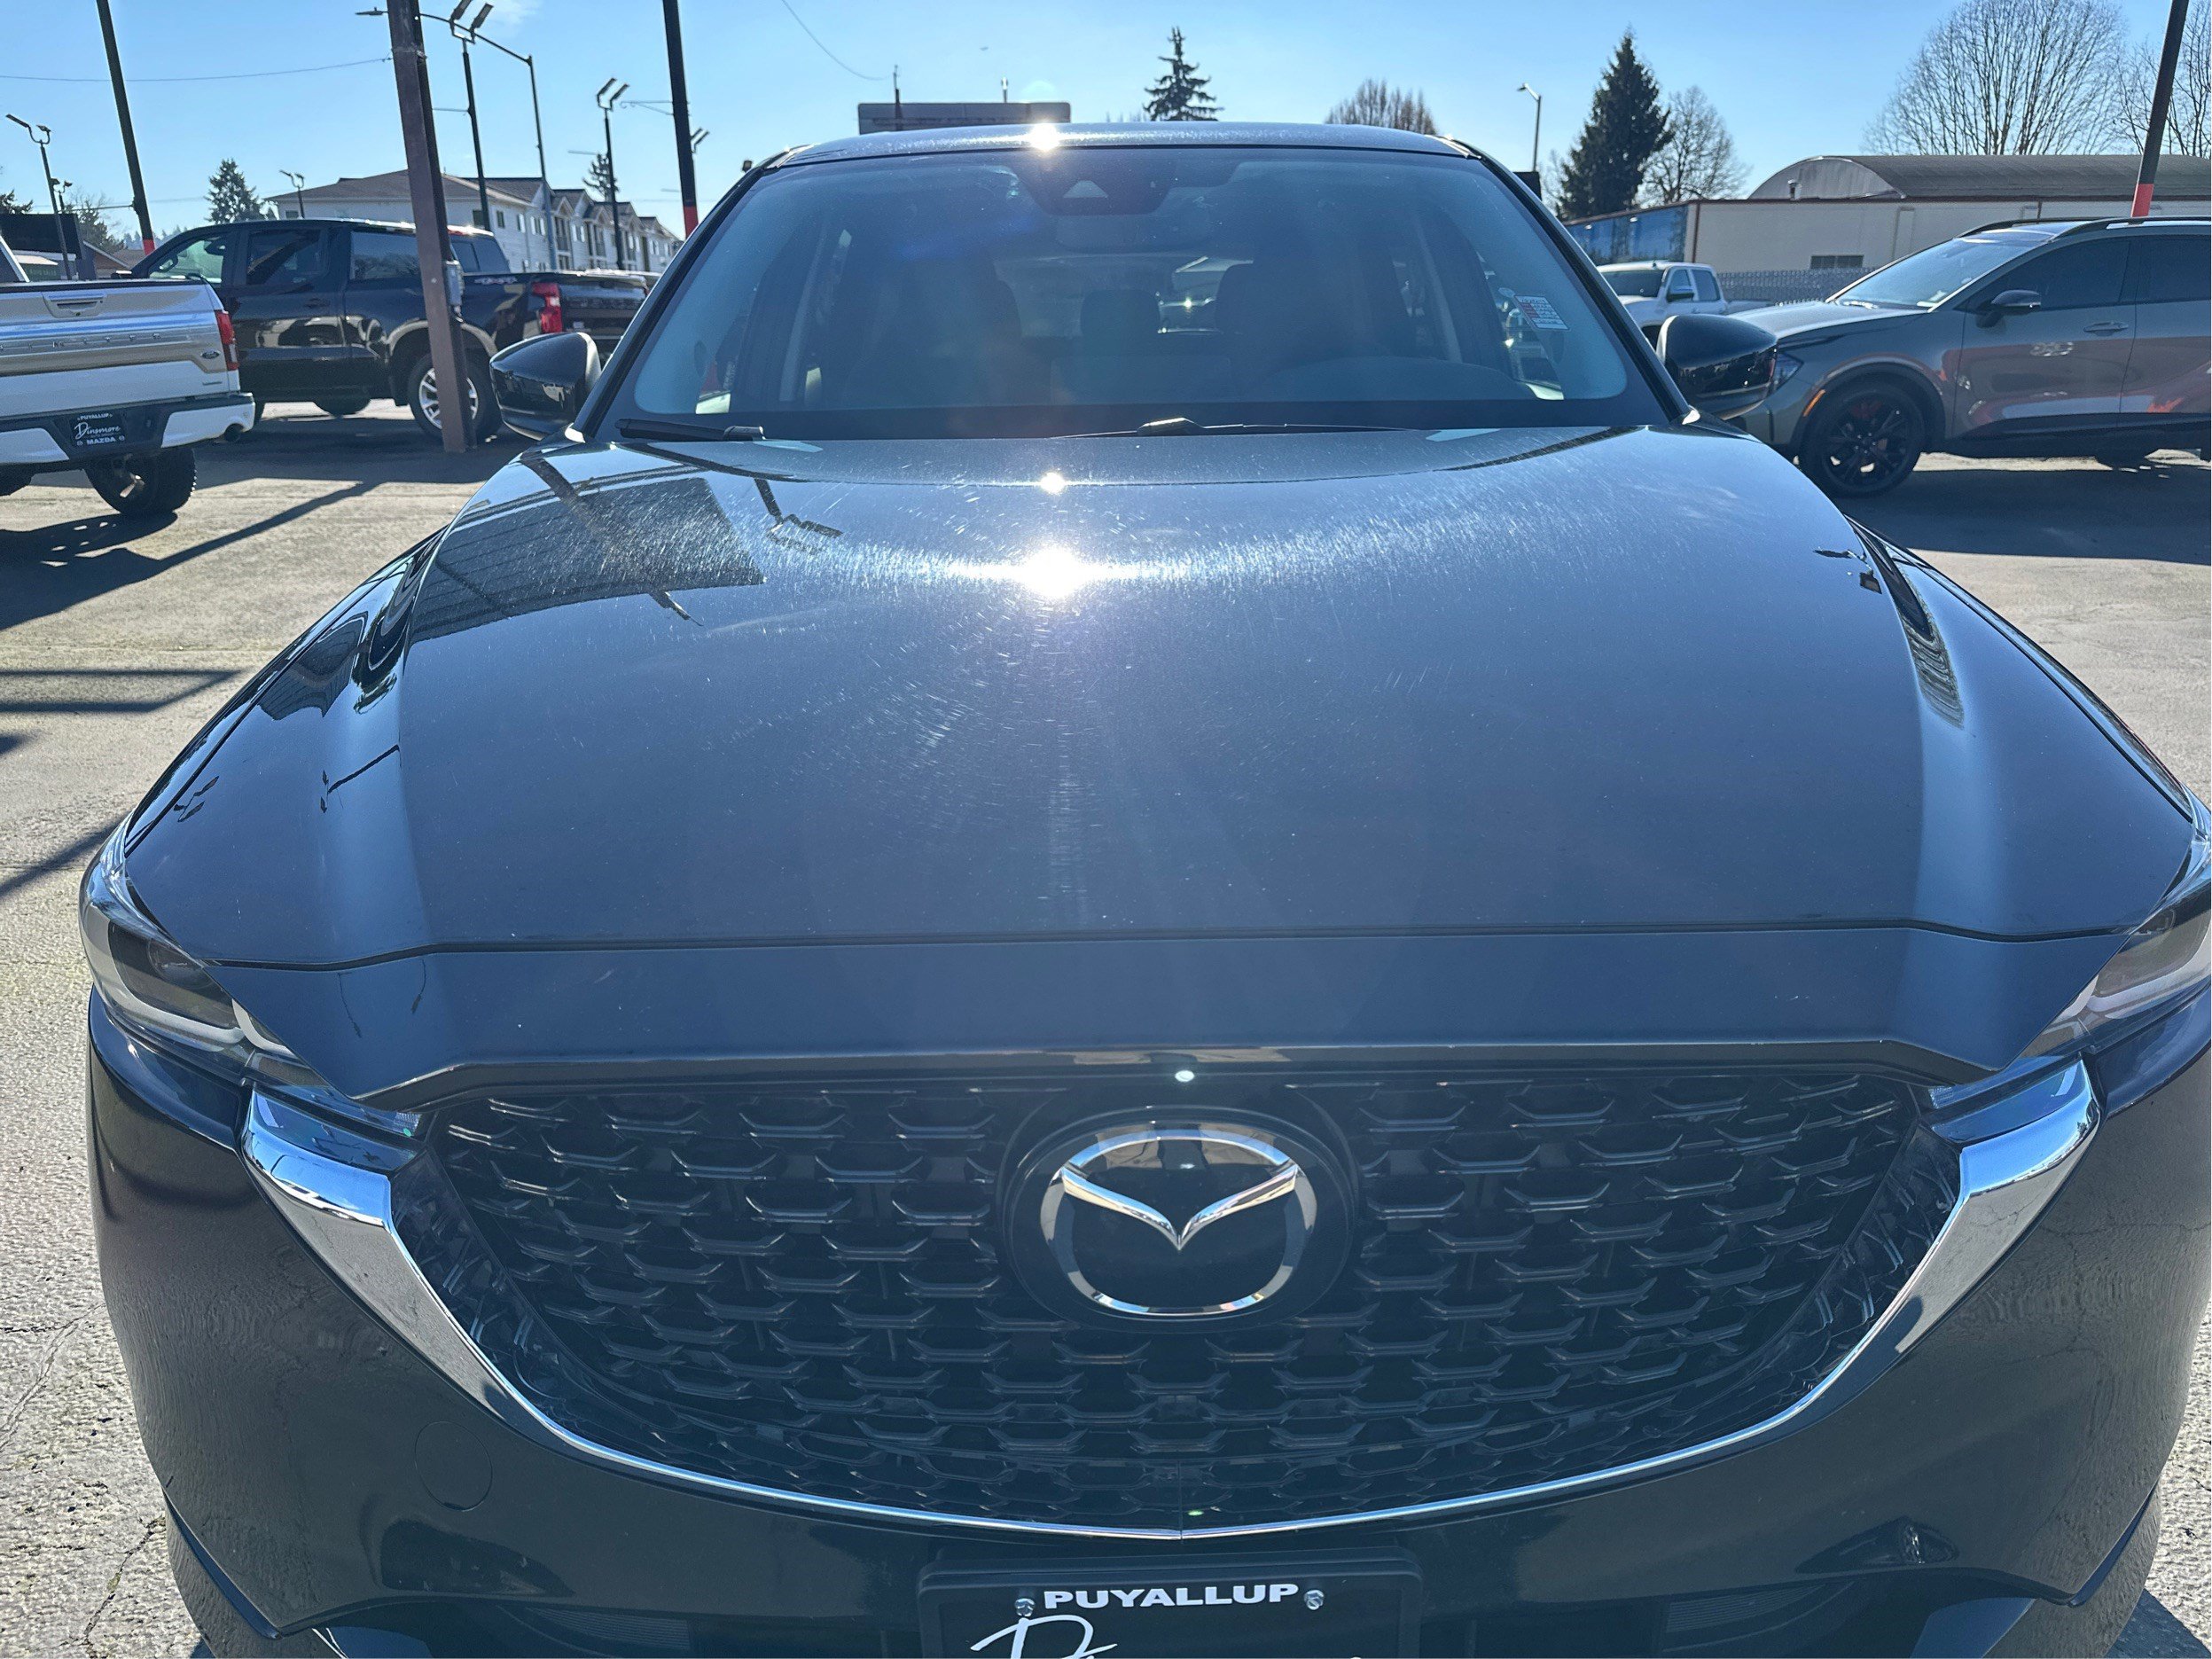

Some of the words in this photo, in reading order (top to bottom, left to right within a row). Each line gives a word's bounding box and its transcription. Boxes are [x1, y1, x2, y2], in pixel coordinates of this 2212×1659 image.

[74, 421, 121, 440] Dinsmore
[86, 436, 116, 445] MAZDA
[1043, 1584, 1299, 1609] PUYALLUP
